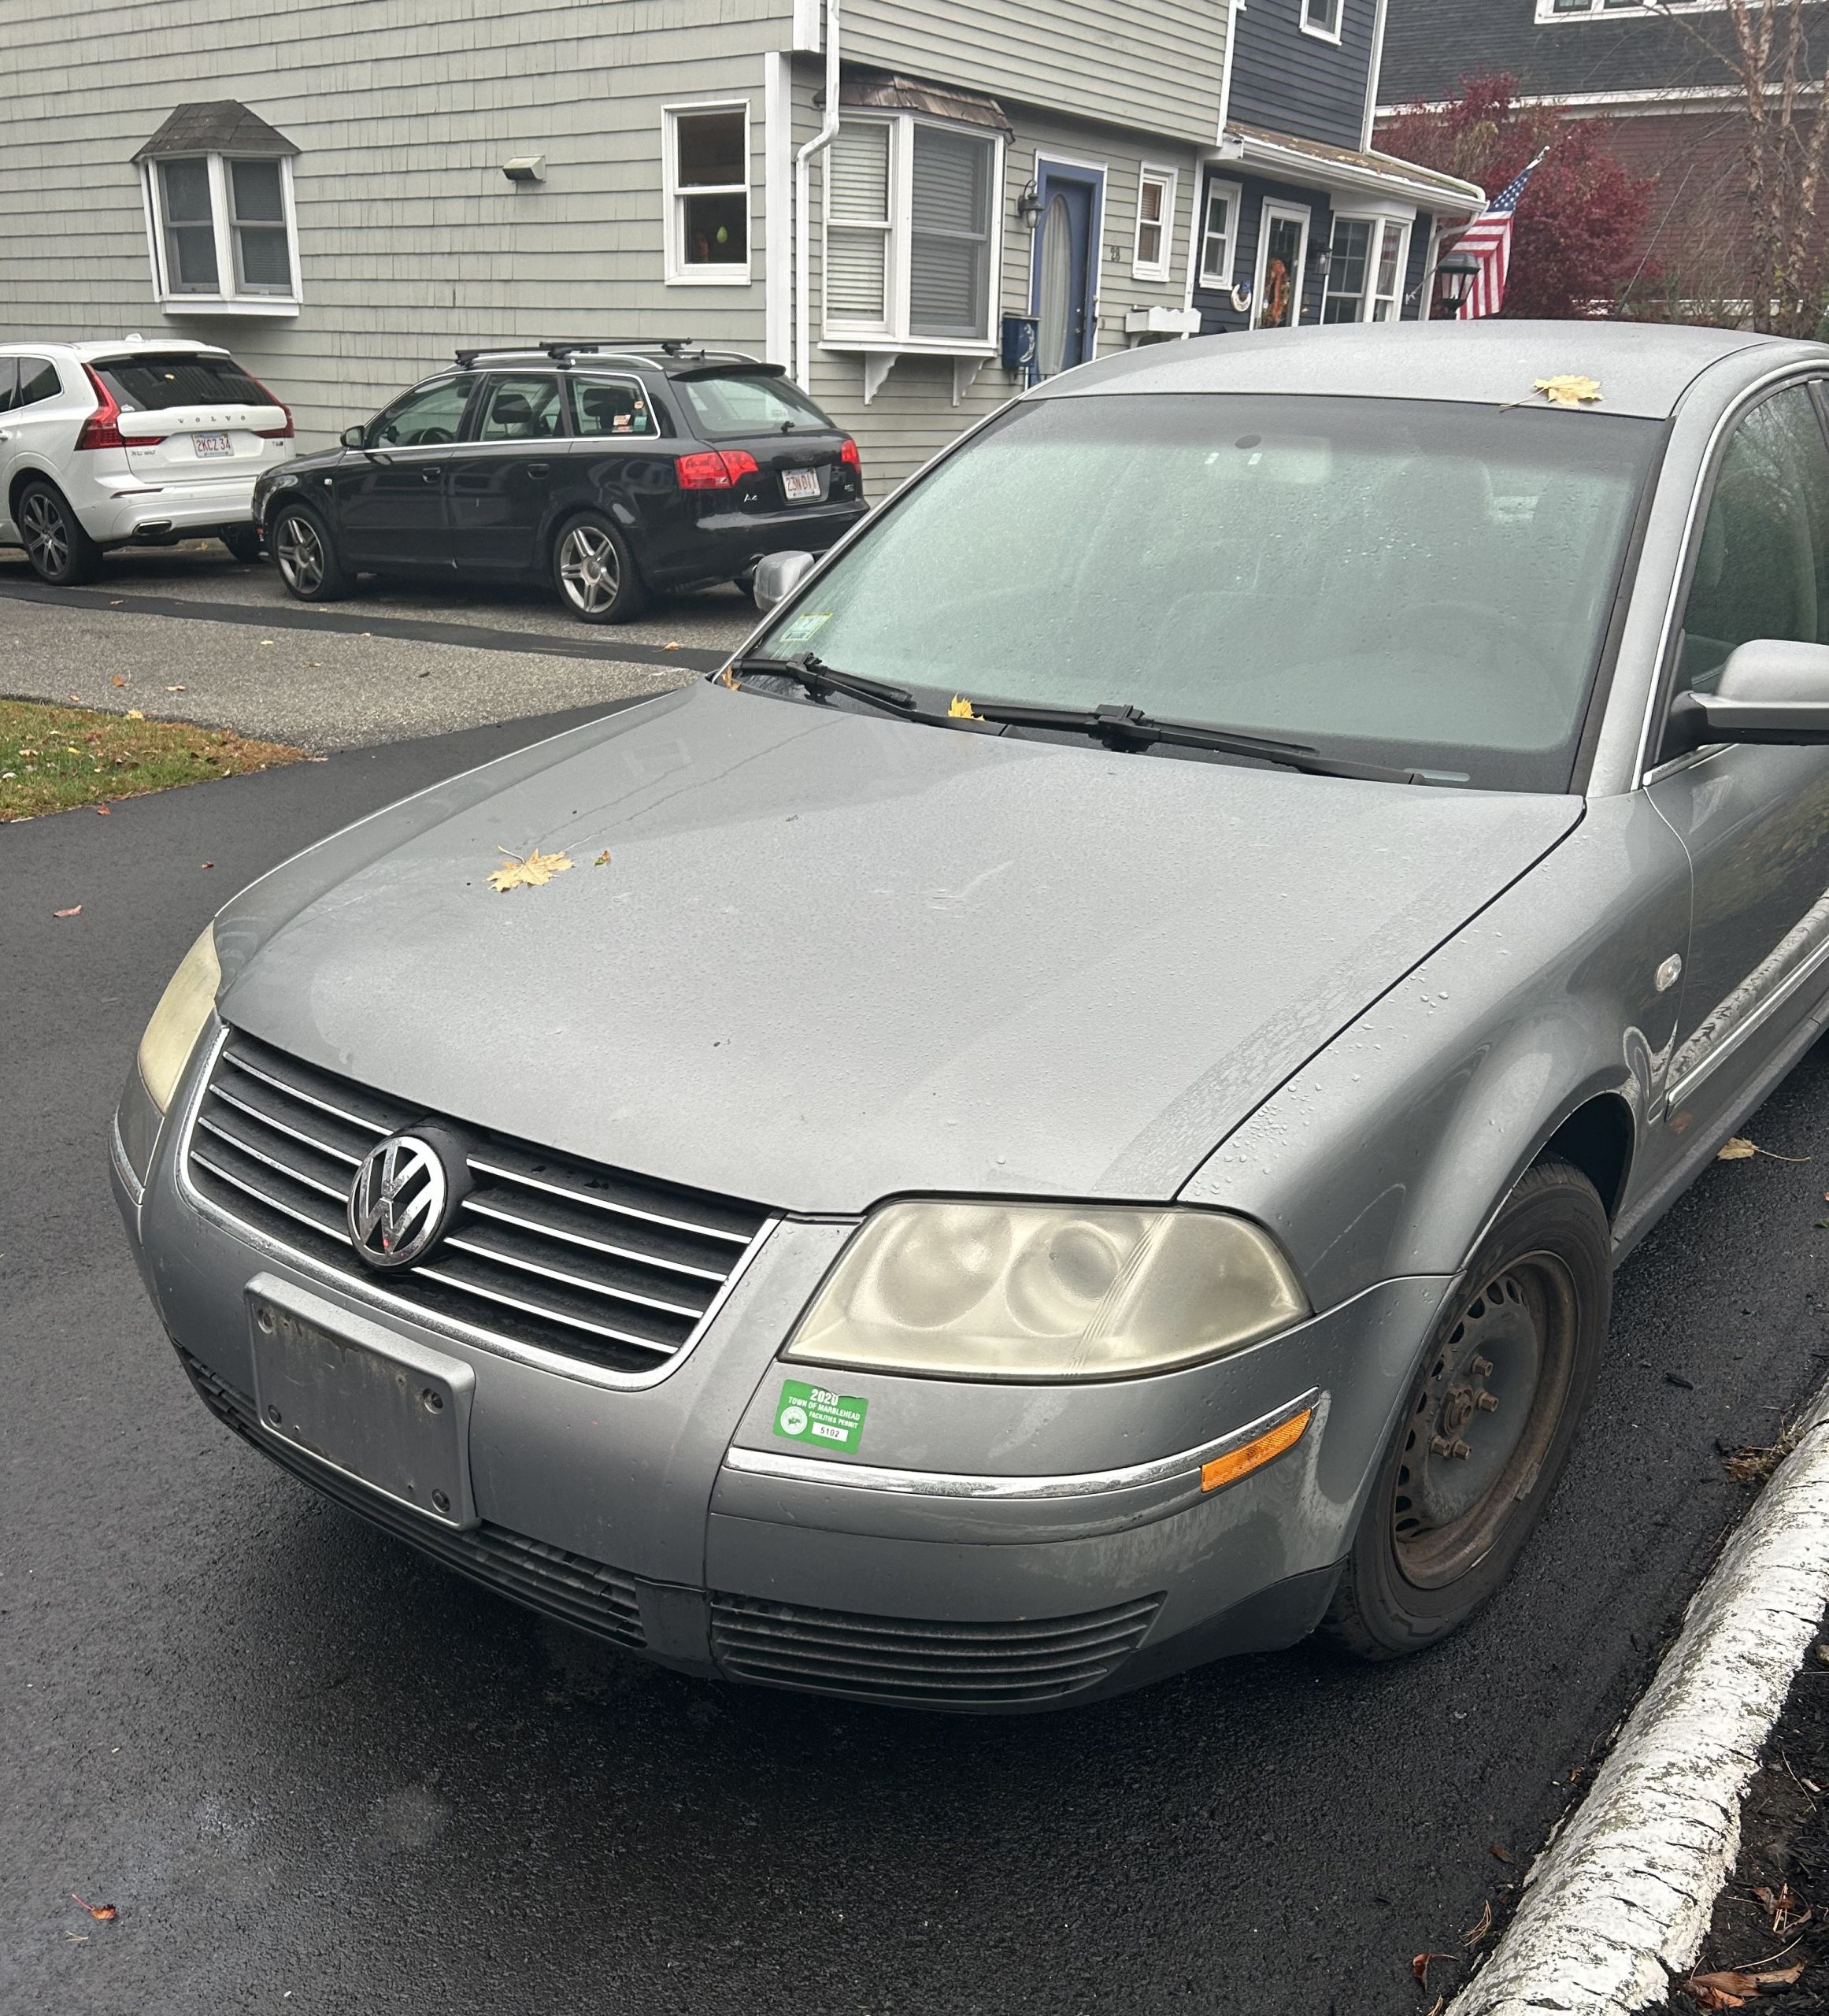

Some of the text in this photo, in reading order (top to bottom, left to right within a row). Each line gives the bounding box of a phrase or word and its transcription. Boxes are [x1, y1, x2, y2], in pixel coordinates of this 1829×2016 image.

[196, 439, 219, 452] 2KCZ
[743, 494, 758, 502] A4
[810, 1388, 839, 1406] 2020
[788, 1395, 807, 1407] TOWN
[808, 1401, 817, 1410] OF
[818, 1403, 861, 1421] MARBLEHEAD
[809, 1411, 837, 1424] FACILITIES
[838, 1419, 859, 1429] PERMIT
[820, 1427, 840, 1438] 5102
